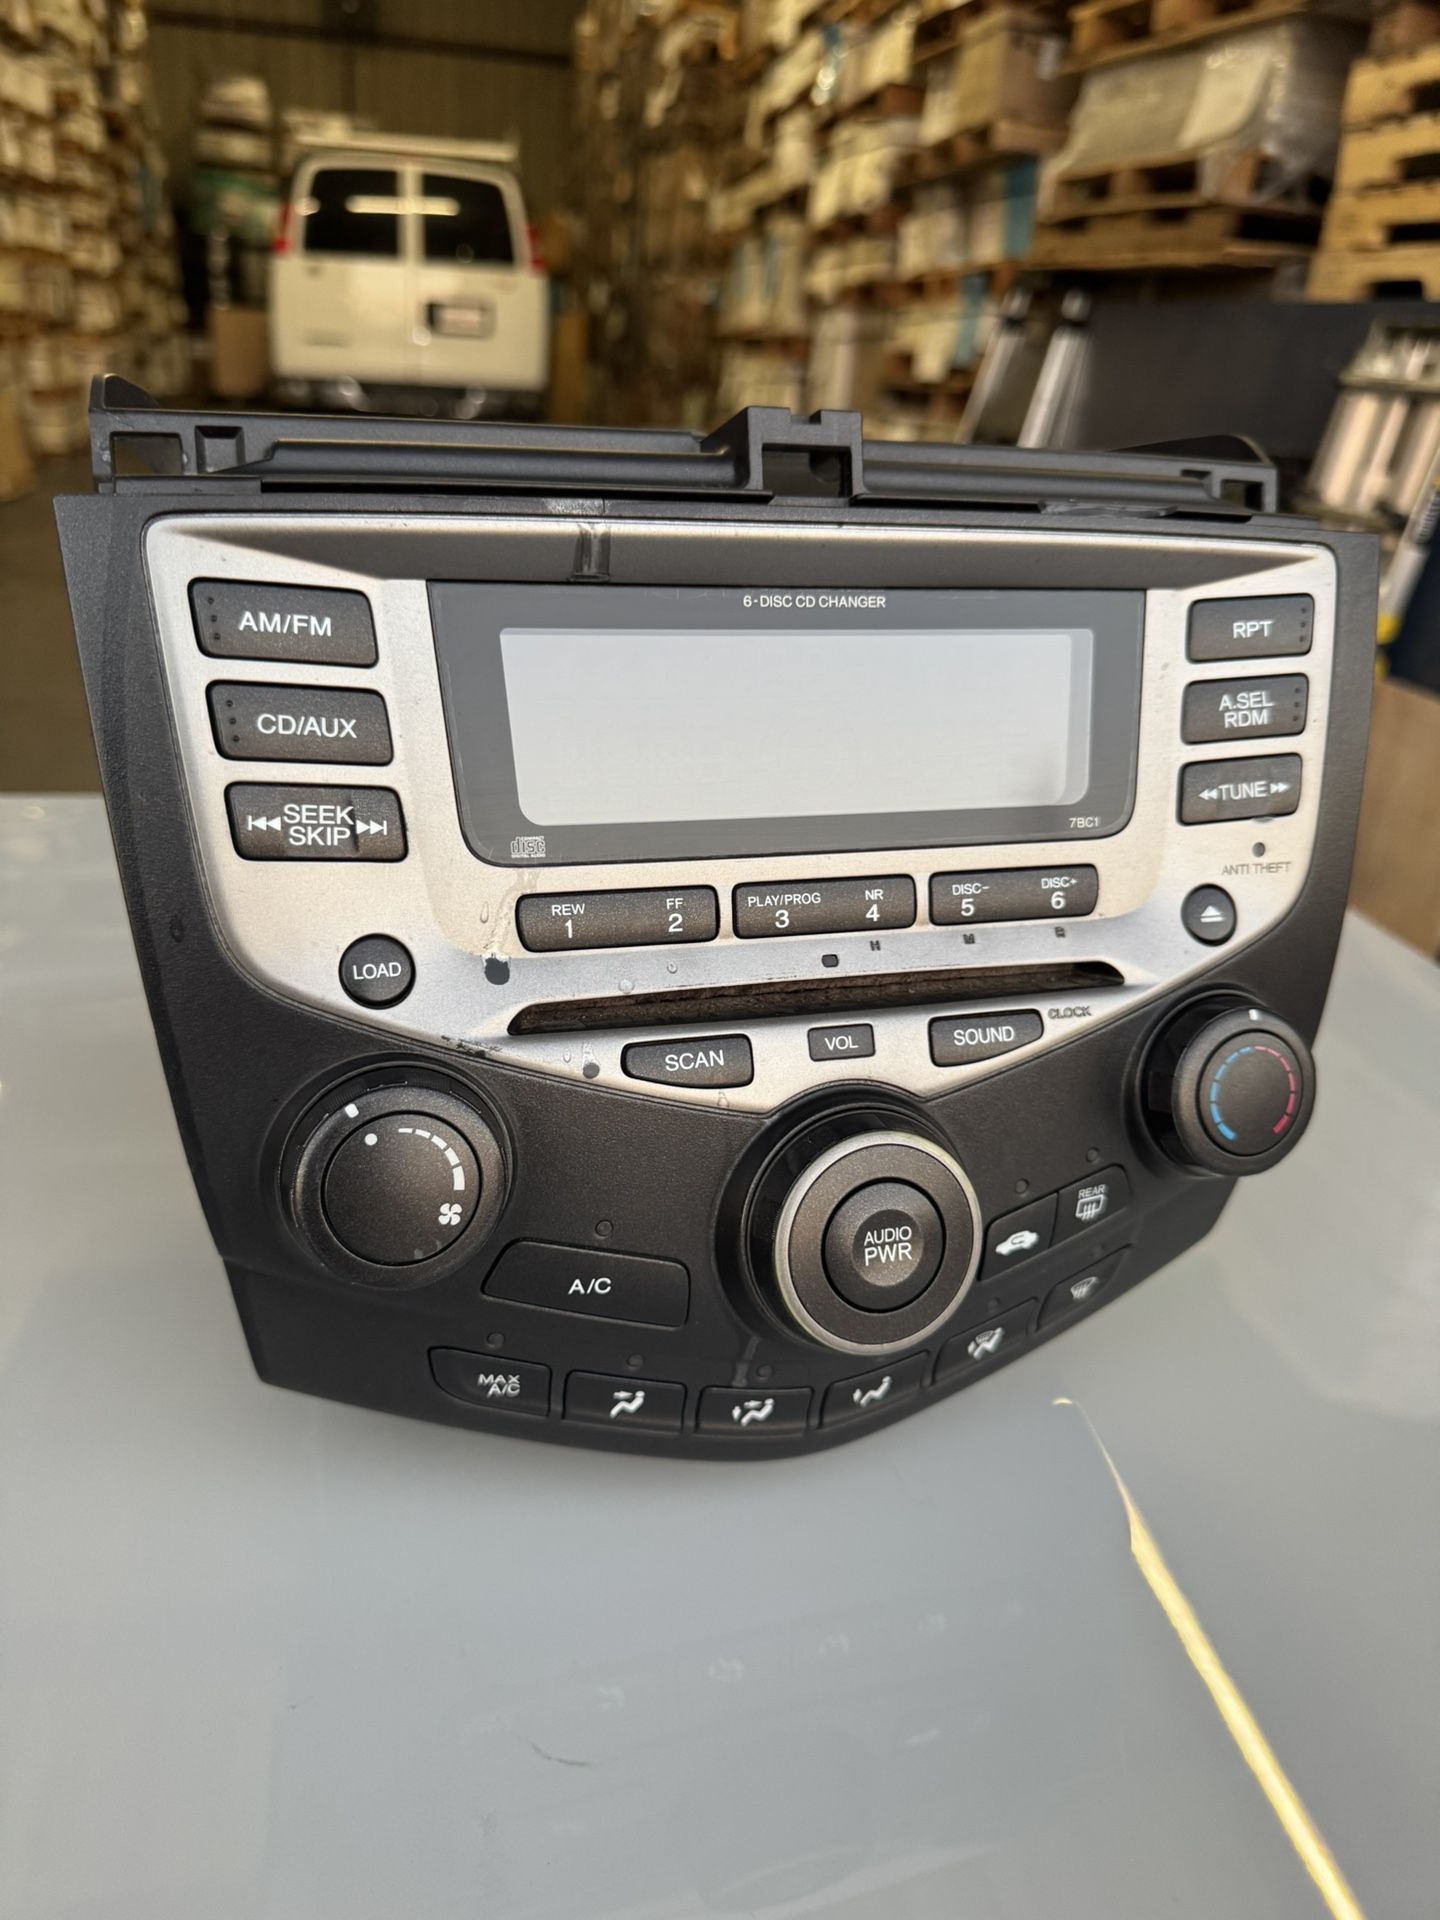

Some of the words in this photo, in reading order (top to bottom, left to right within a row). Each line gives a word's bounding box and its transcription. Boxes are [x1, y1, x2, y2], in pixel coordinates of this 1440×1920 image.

[743, 595, 792, 608] 6-DISC
[795, 595, 815, 608] CD
[818, 595, 886, 609] CHANGER
[239, 611, 332, 636] AM/FM
[1232, 621, 1272, 639] RPT
[1219, 692, 1273, 711] A.SEL
[257, 714, 357, 739] CD/AUX
[1224, 710, 1268, 729] RDM
[1219, 781, 1268, 799] TUNE
[283, 804, 354, 825] SEEK
[1068, 816, 1099, 828] 7BC1
[288, 826, 351, 847] SKIP
[1221, 863, 1249, 876] ANTI
[1252, 861, 1292, 874] THEFT
[666, 898, 684, 909] FF
[747, 892, 822, 908] PLAY/PROG
[865, 889, 884, 901] NR
[1051, 893, 1065, 909] 6
[551, 903, 586, 916] REW
[865, 905, 880, 922] 4
[960, 899, 975, 916] 5
[668, 913, 684, 932] 2
[774, 910, 790, 928] 3
[565, 919, 574, 938] 1
[353, 961, 402, 980] LOAD
[1048, 1005, 1091, 1020] CLOCK
[825, 1035, 859, 1050] VOL
[953, 1026, 1015, 1046] SOUND
[665, 1050, 724, 1072] SCAN
[1078, 1184, 1106, 1199] REAR
[864, 1225, 912, 1246] AUDIO
[864, 1242, 913, 1267] PWR
[567, 1277, 612, 1295] A/C
[478, 1373, 520, 1386] MAX
[487, 1383, 520, 1398] A/C
